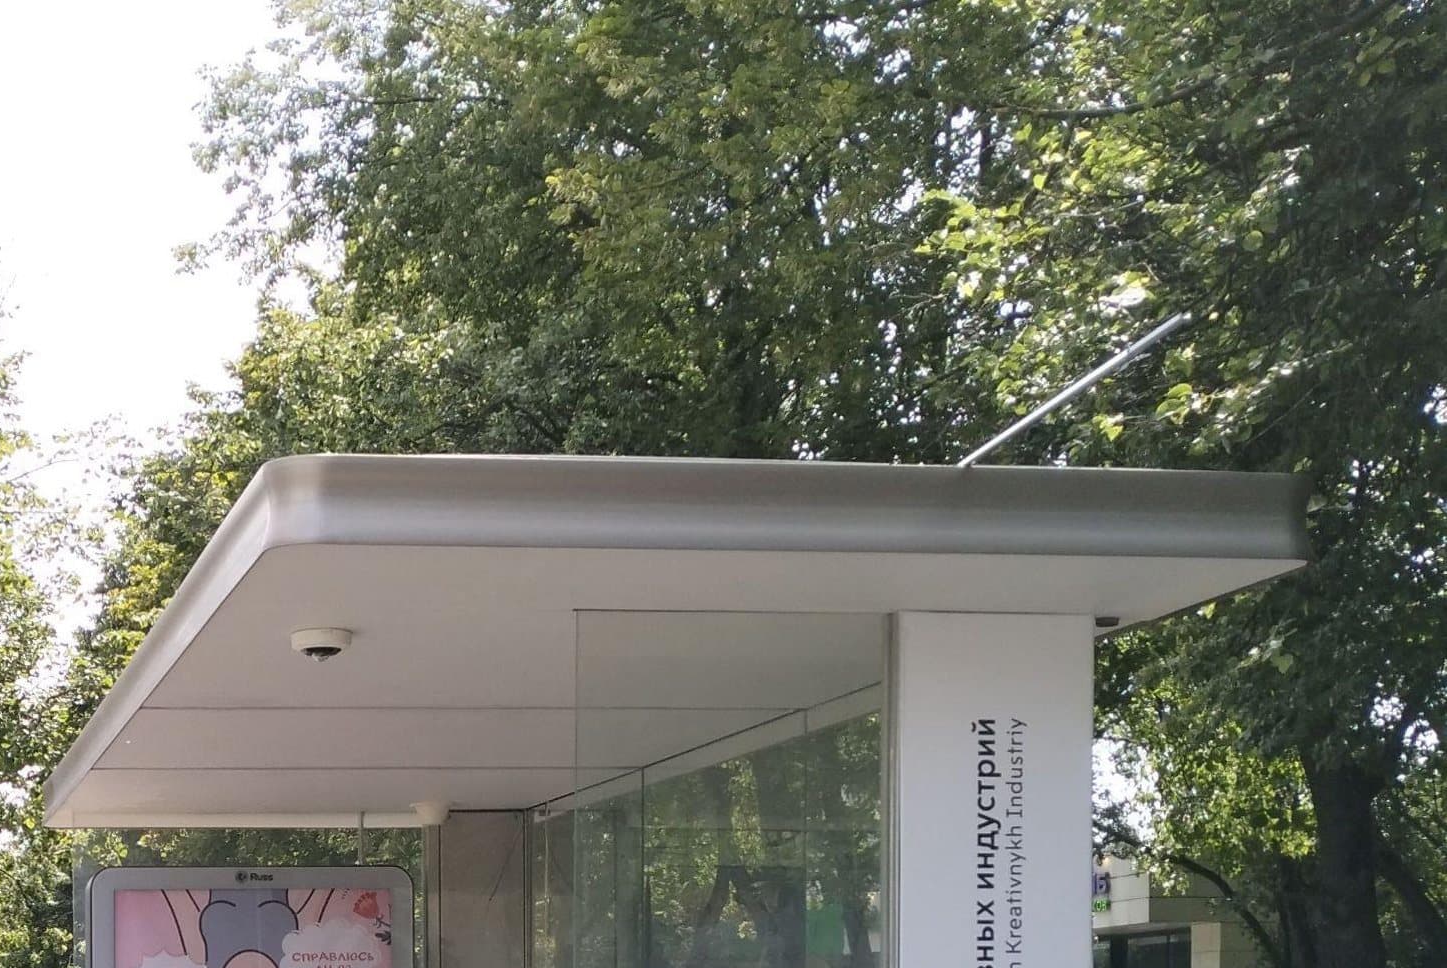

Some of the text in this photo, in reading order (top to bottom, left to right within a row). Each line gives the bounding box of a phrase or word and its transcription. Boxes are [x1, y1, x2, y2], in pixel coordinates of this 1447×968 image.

[971, 718, 1002, 889] индустрий
[1005, 718, 1028, 817] Industriy
[250, 873, 273, 881] Russ
[1005, 826, 1026, 954] Kreativnykh
[292, 951, 374, 962] СПРАВЛЮСЬ
